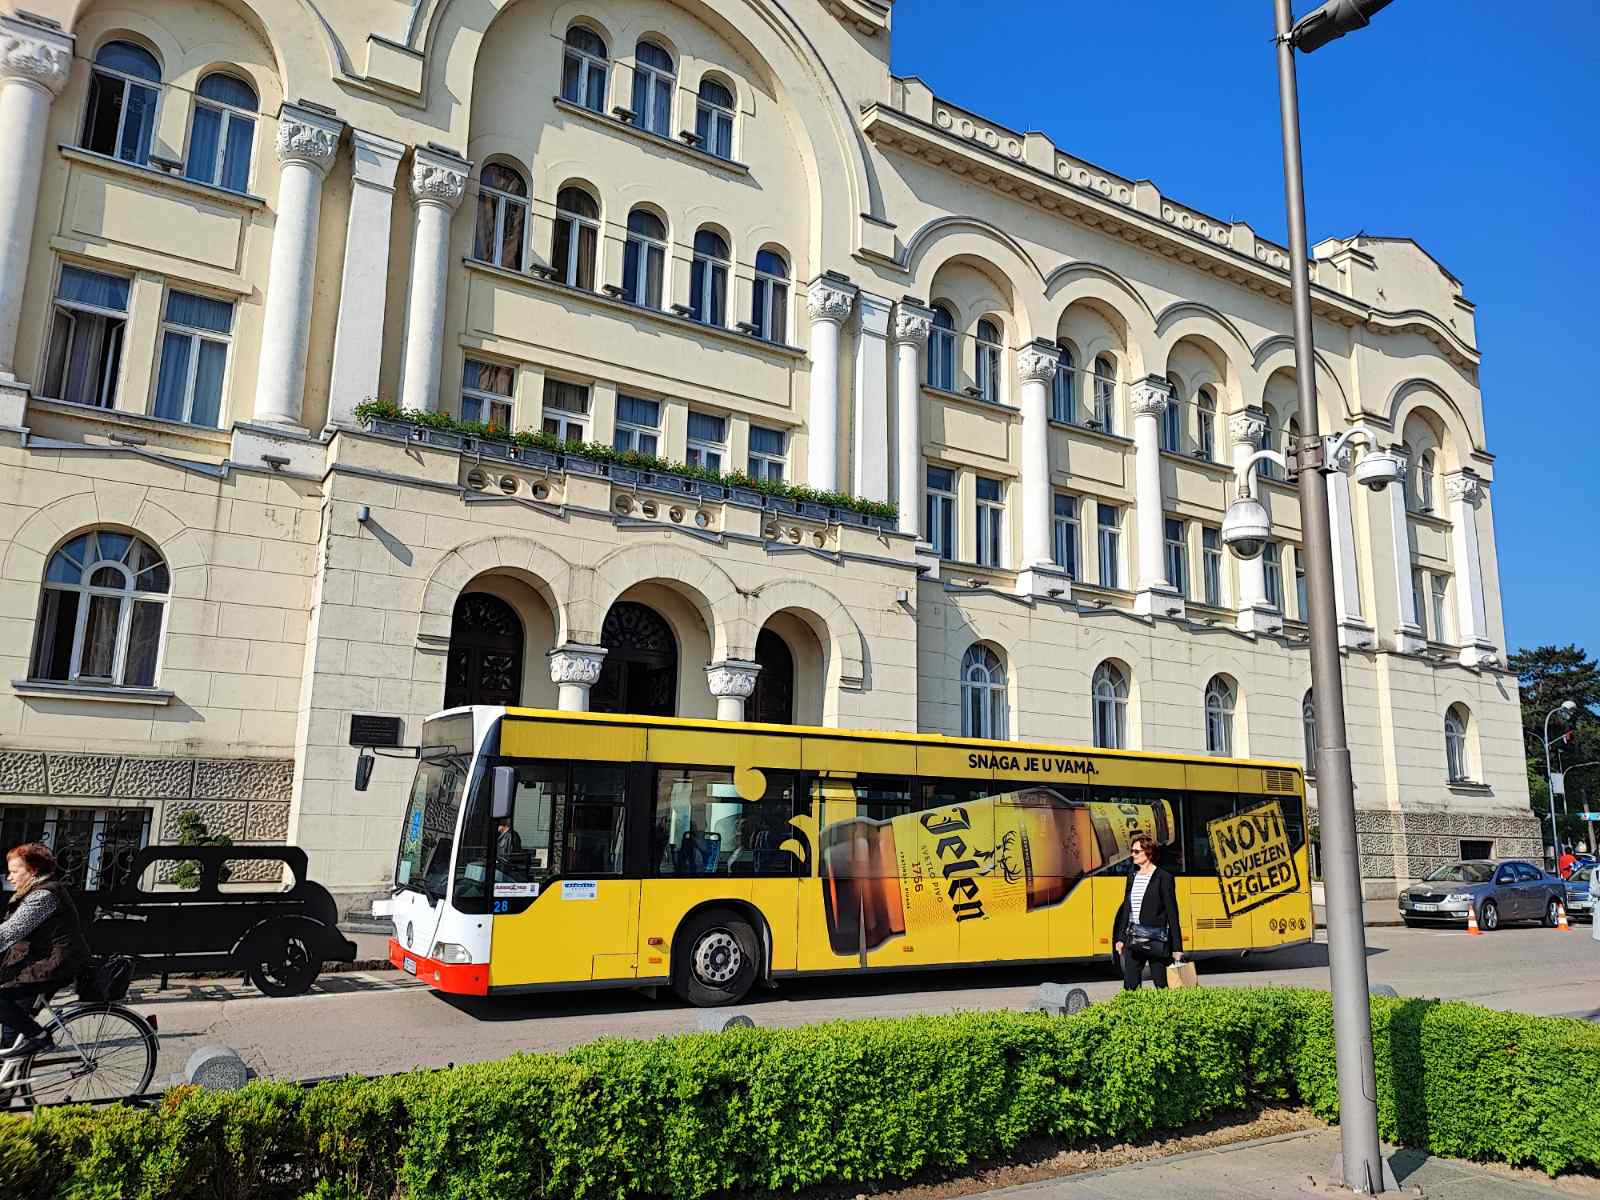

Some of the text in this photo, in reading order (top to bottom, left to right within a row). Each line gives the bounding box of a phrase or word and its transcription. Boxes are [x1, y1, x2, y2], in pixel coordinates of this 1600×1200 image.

[968, 754, 1100, 775] SNAGA JE U VAMA.
[1215, 809, 1282, 858] NOVI
[911, 862, 924, 893] 1756
[920, 807, 984, 923] Jelen
[1223, 842, 1287, 879] OSVJEŽEN
[932, 881, 944, 904] PIVO
[1227, 861, 1292, 905] IZGLED
